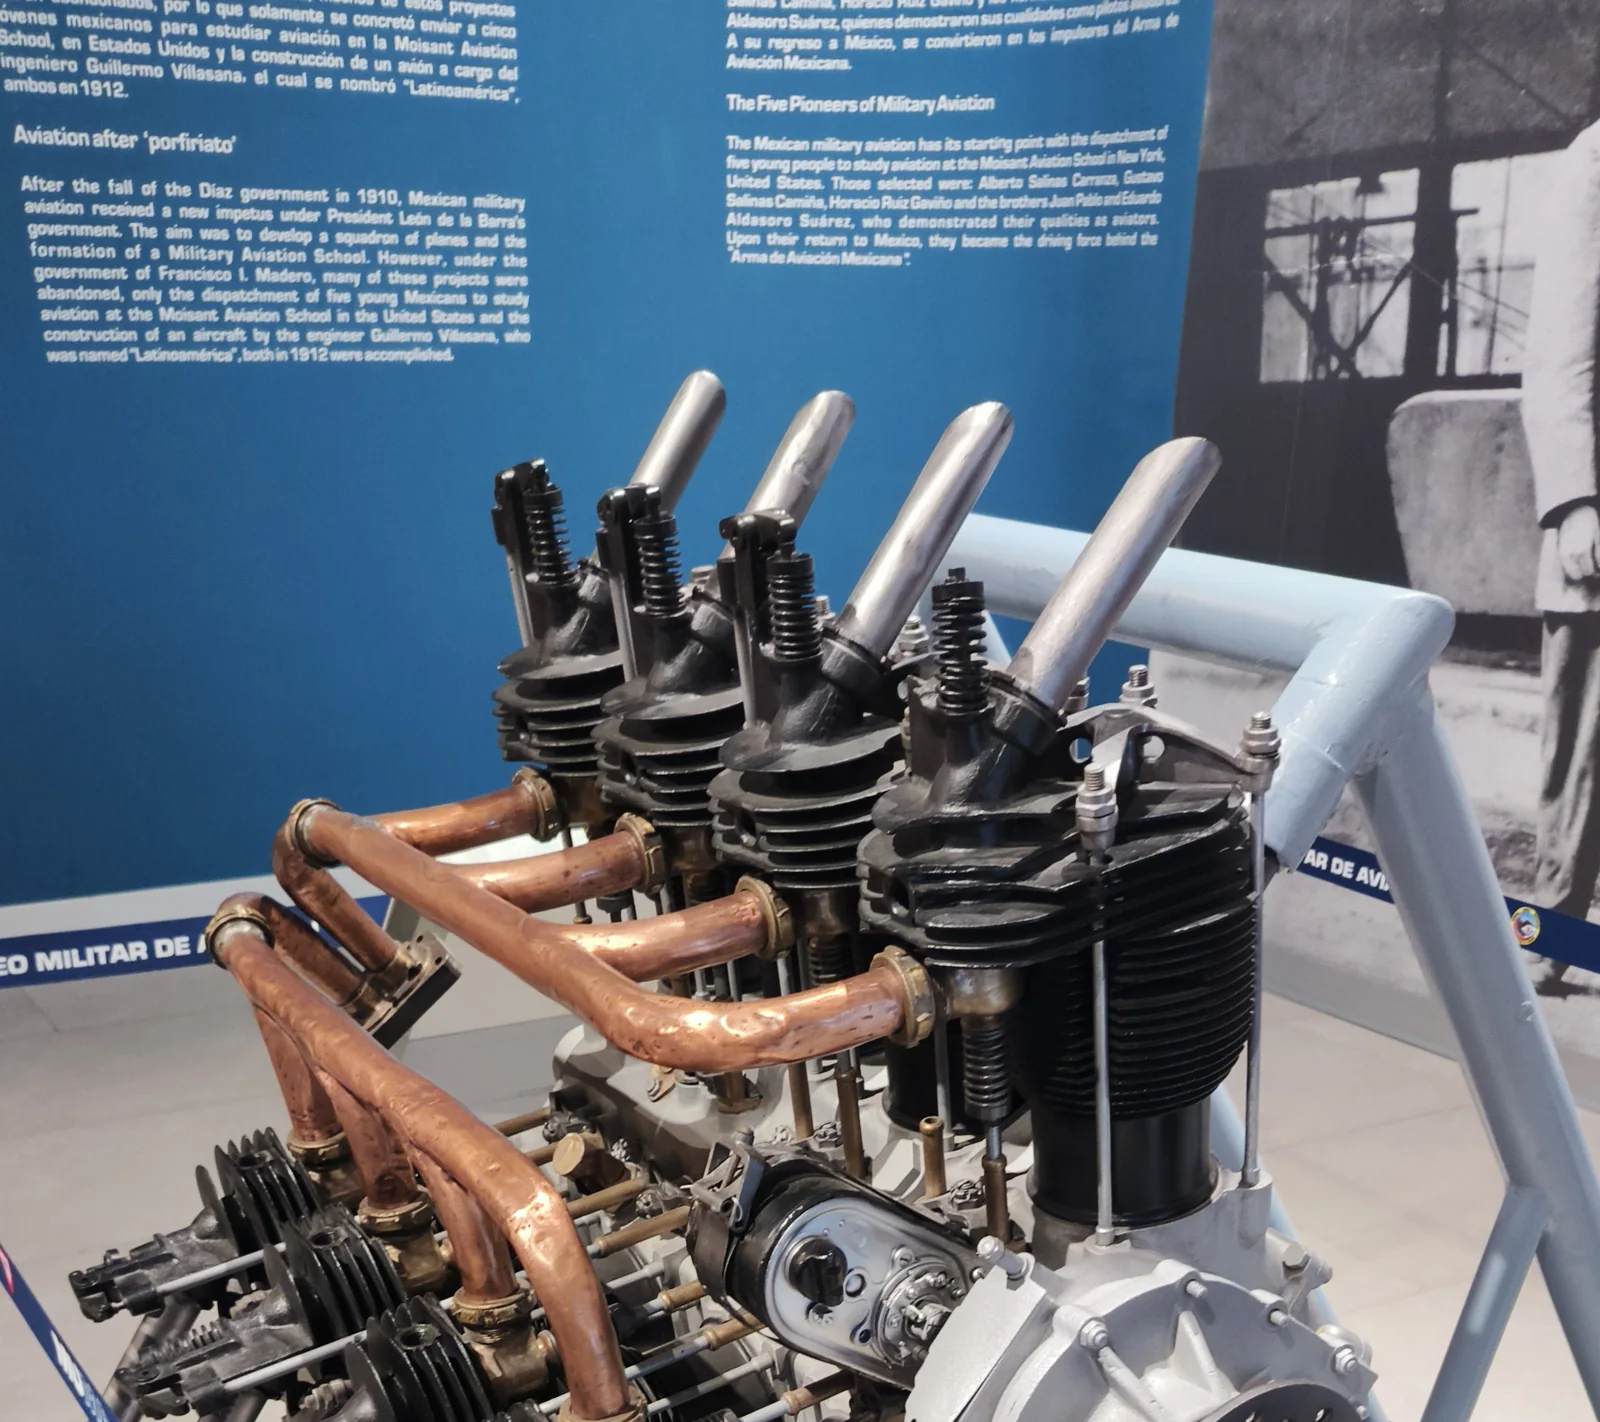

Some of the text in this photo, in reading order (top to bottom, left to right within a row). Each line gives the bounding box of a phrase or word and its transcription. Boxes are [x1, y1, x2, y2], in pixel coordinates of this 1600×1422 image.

[163, 0, 189, 15] por
[196, 0, 210, 14] lo
[216, 4, 243, 19] que
[249, 4, 324, 23] solamente
[330, 13, 347, 25] se
[353, 14, 415, 31] concretó
[467, 24, 476, 36] a
[481, 22, 516, 37] cinco
[405, 0, 443, 11] estos
[449, 0, 515, 23] proyectos
[0, 4, 57, 26] óvenes
[66, 13, 152, 33] mexicanos
[160, 22, 197, 41] para
[206, 24, 270, 40] estudiar
[279, 28, 340, 46] aviación
[348, 36, 366, 48] en
[373, 34, 387, 50] la
[394, 35, 454, 55] Moisant
[461, 41, 517, 60] Aviation
[727, 33, 738, 48] A
[744, 37, 761, 49] su
[768, 38, 822, 53] regreso
[828, 39, 838, 49] a
[902, 38, 919, 49] se
[1007, 33, 1023, 45] en
[1028, 29, 1045, 44] los
[62, 37, 81, 50] en
[88, 34, 151, 55] Estados
[158, 40, 209, 58] Unidos
[216, 48, 225, 63] y
[231, 45, 245, 60] la
[251, 44, 344, 67] construcción
[350, 55, 368, 69] de
[374, 60, 391, 71] un
[398, 58, 433, 74] avión
[440, 64, 448, 75] a
[454, 65, 493, 83] cargo
[498, 66, 518, 81] del
[0, 52, 77, 74] ingeniero
[86, 57, 163, 78] Guillermo
[254, 69, 268, 85] el
[276, 72, 307, 87] cual
[315, 77, 332, 89] se
[340, 77, 396, 93] nombró
[4, 77, 129, 97] ambos en 1912.
[726, 94, 995, 116] The Five Pioneers of Military Aviation
[14, 124, 89, 146] Aviation
[92, 129, 137, 149] after
[726, 135, 752, 150] The
[753, 136, 810, 151] Mexican
[864, 138, 916, 152] aviation
[918, 138, 943, 152] has
[21, 176, 63, 192] After
[72, 178, 100, 194] the
[108, 179, 133, 195] fall
[141, 181, 156, 196] of
[165, 182, 191, 197] the
[199, 182, 232, 199] Díaz
[240, 188, 329, 208] government
[336, 188, 349, 203] in
[356, 189, 402, 207] 1910,
[408, 191, 467, 207] Mexican
[25, 198, 84, 215] aviation
[92, 202, 154, 217] received
[162, 206, 171, 218] a
[179, 207, 209, 219] new
[216, 205, 273, 223] impetus
[280, 208, 320, 222] under
[327, 208, 393, 225] President
[437, 212, 454, 227] de
[459, 213, 472, 227] la
[726, 212, 792, 227] Aldasoro
[799, 213, 854, 229] Suárez,
[862, 215, 892, 228] who
[898, 215, 997, 229] demonstrated
[1003, 215, 1034, 228] their
[1095, 216, 1107, 226] as
[27, 222, 526, 250] government. The aim was to develop a squadron of planes and the
[726, 230, 760, 250] Upon
[766, 232, 798, 246] their
[804, 234, 847, 246] return
[853, 235, 868, 247] to
[928, 234, 956, 251] they
[1013, 234, 1033, 247] the
[31, 241, 527, 267] formation of a Military Aviation School. However, under the
[34, 267, 128, 283] government
[135, 265, 150, 280] of
[158, 264, 232, 282] Francisco
[255, 267, 315, 284] Madero,
[322, 272, 360, 287] many
[367, 270, 381, 284] of
[387, 270, 427, 285] these
[433, 272, 489, 288] projects
[495, 276, 528, 287] were
[1330, 856, 1355, 879] DE
[34, 940, 148, 972] MILITAR
[153, 935, 191, 958] DE
